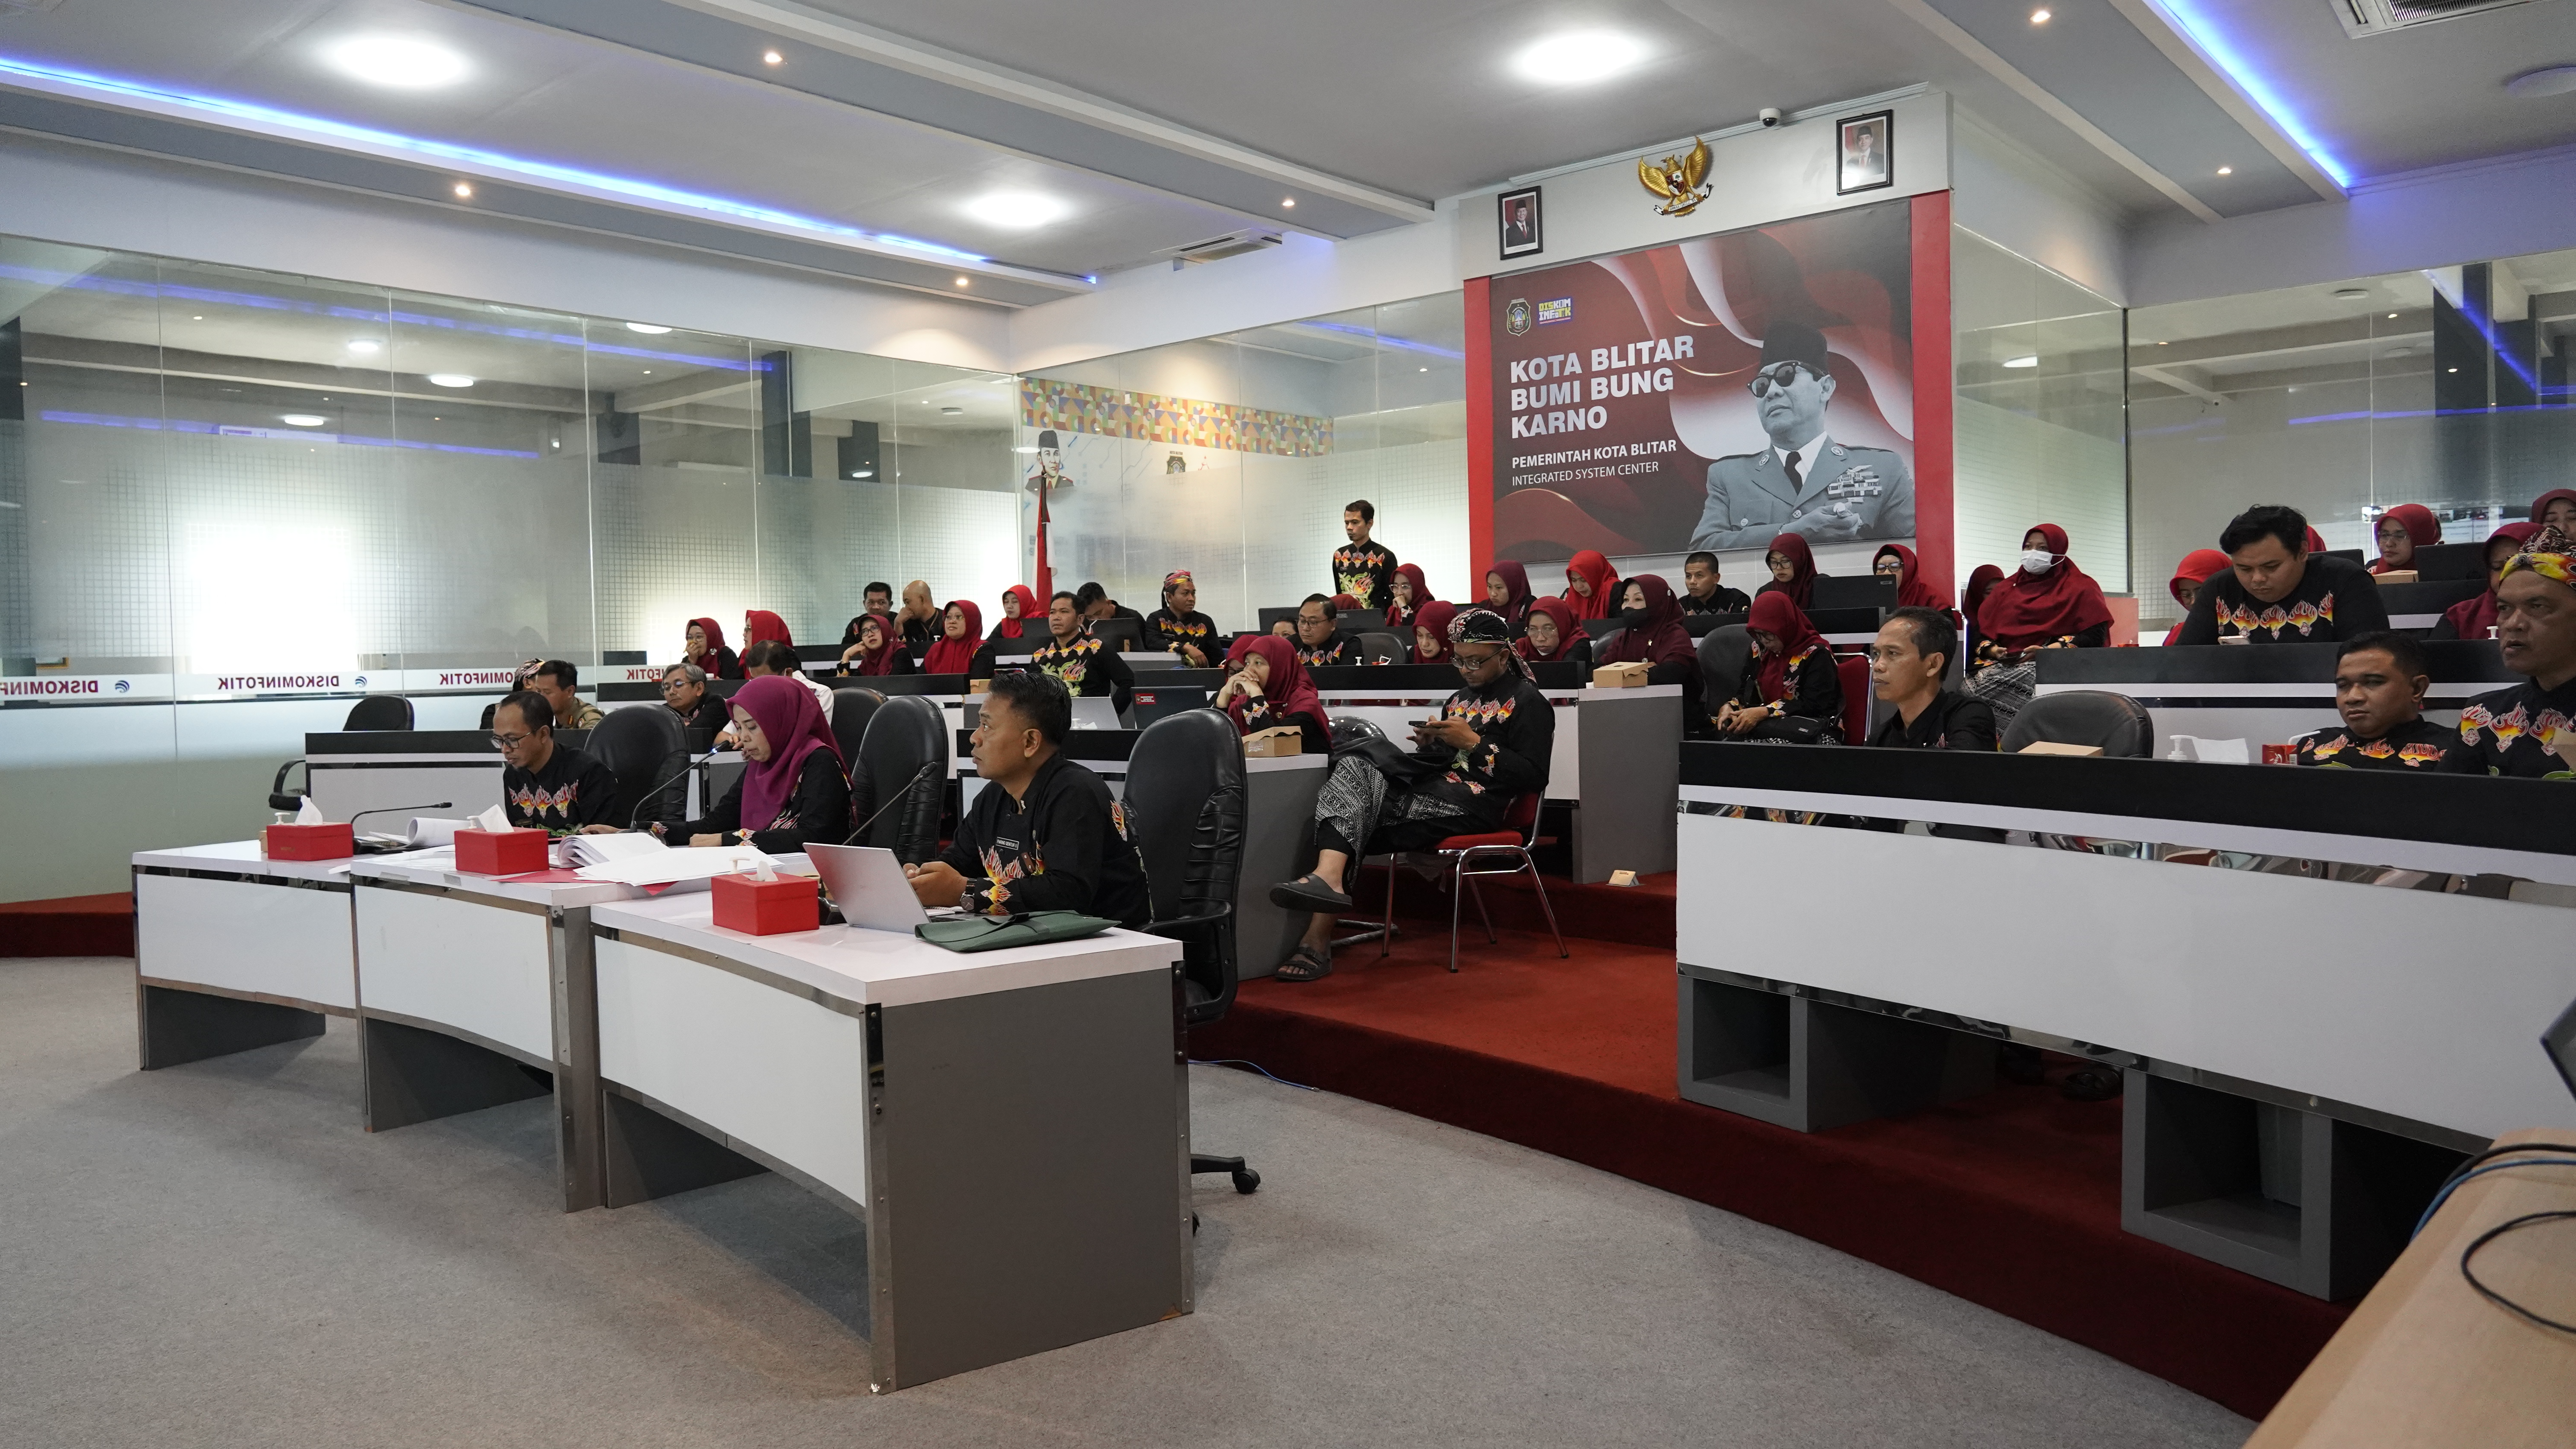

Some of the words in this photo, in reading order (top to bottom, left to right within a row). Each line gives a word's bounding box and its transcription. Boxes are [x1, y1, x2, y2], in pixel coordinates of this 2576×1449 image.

[1539, 298, 1571, 311] DISKOM
[1510, 352, 1583, 383] KOTA
[1591, 335, 1694, 372] BLITAR
[1511, 380, 1580, 411] BUMI
[1591, 367, 1674, 400] BUNG
[1512, 406, 1607, 439] KARNO
[1512, 449, 1591, 469] PEMERINTAH
[1594, 445, 1628, 460] KOTA
[1631, 439, 1677, 456] BLITAR
[1512, 470, 1573, 486] INTEGRATED
[1575, 465, 1615, 479] SYSTEM
[1618, 461, 1659, 476] CENTER
